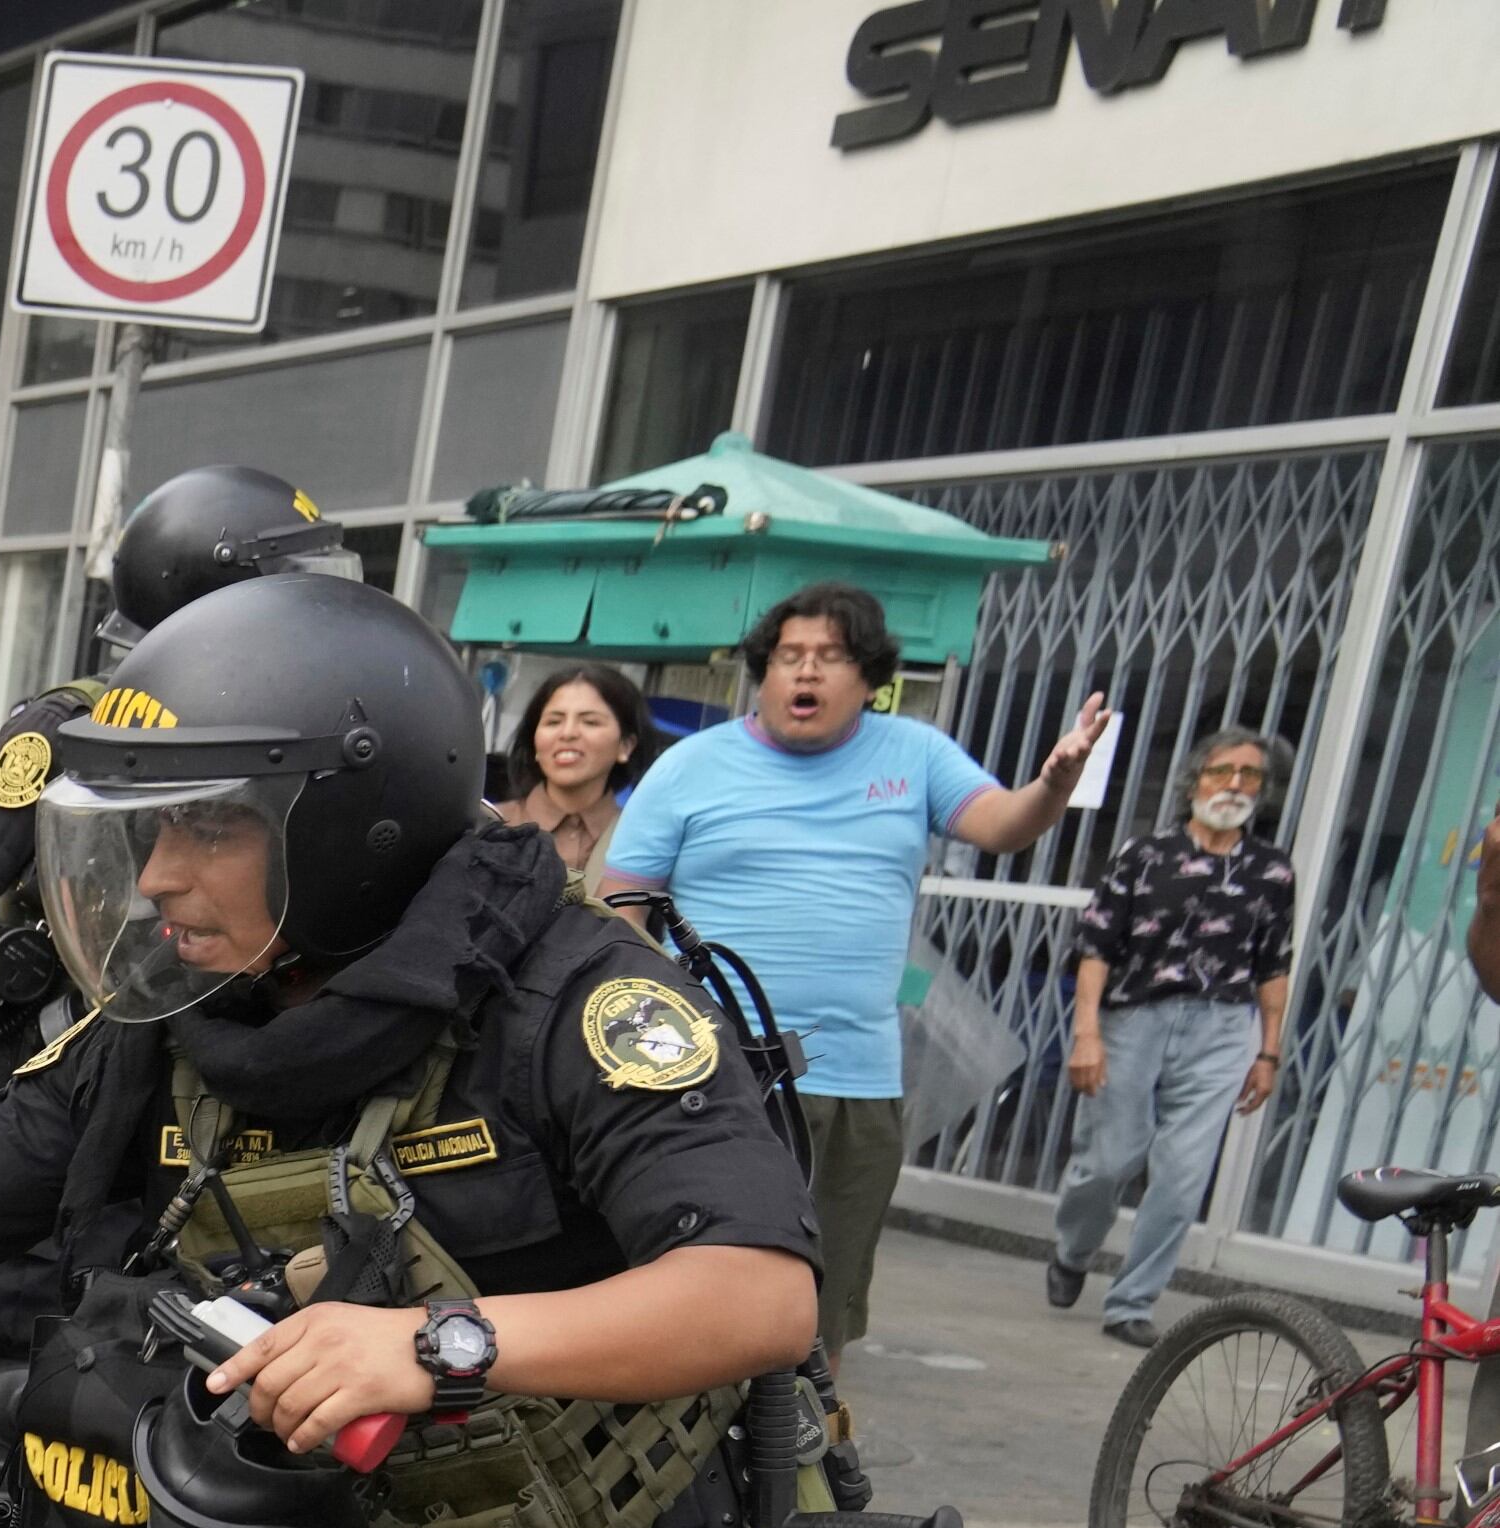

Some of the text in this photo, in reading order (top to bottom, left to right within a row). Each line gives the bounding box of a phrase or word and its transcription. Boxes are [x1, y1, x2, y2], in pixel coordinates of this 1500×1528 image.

[830, 0, 1388, 150] SENA
[96, 126, 221, 224] 30
[603, 994, 637, 1018] GIR
[397, 1133, 488, 1165] POLICIA NACIONAL
